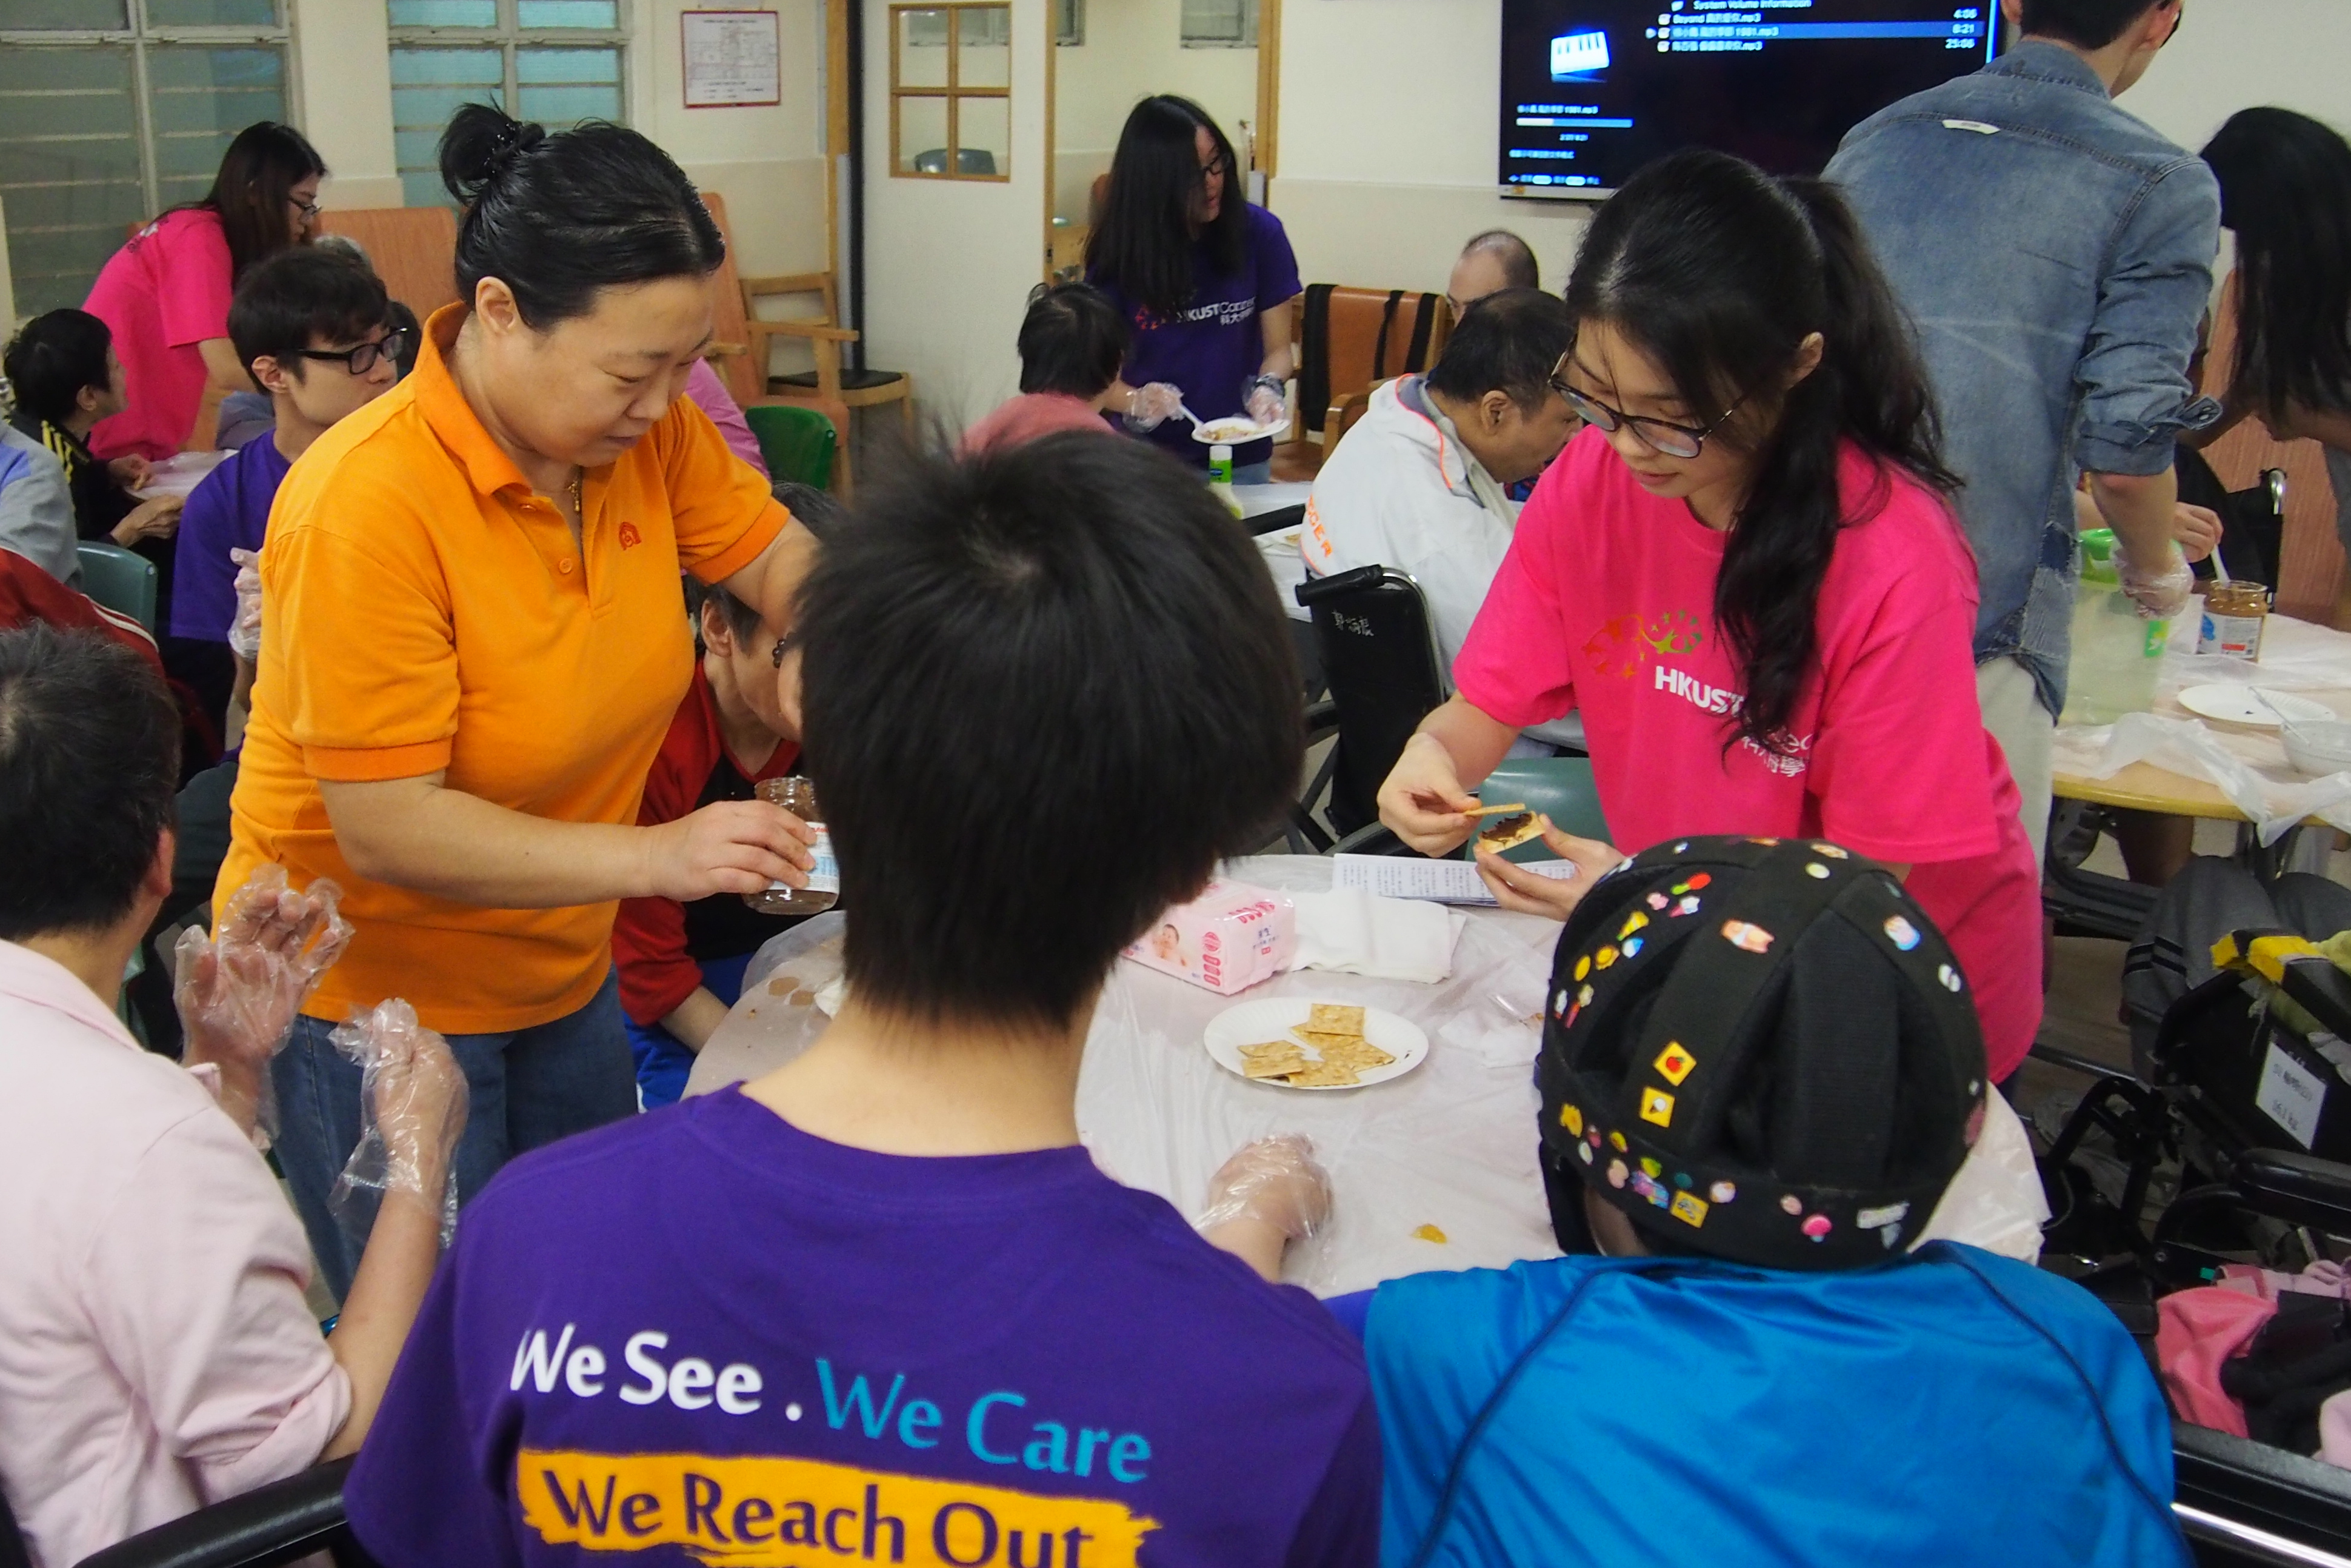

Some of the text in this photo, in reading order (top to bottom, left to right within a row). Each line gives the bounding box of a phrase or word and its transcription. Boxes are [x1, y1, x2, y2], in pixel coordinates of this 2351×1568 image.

[510, 1323, 605, 1398] We
[619, 1330, 762, 1415] See
[815, 1357, 943, 1449] We
[965, 1391, 1152, 1484] Care
[542, 1469, 1094, 1568] We Reach Out
